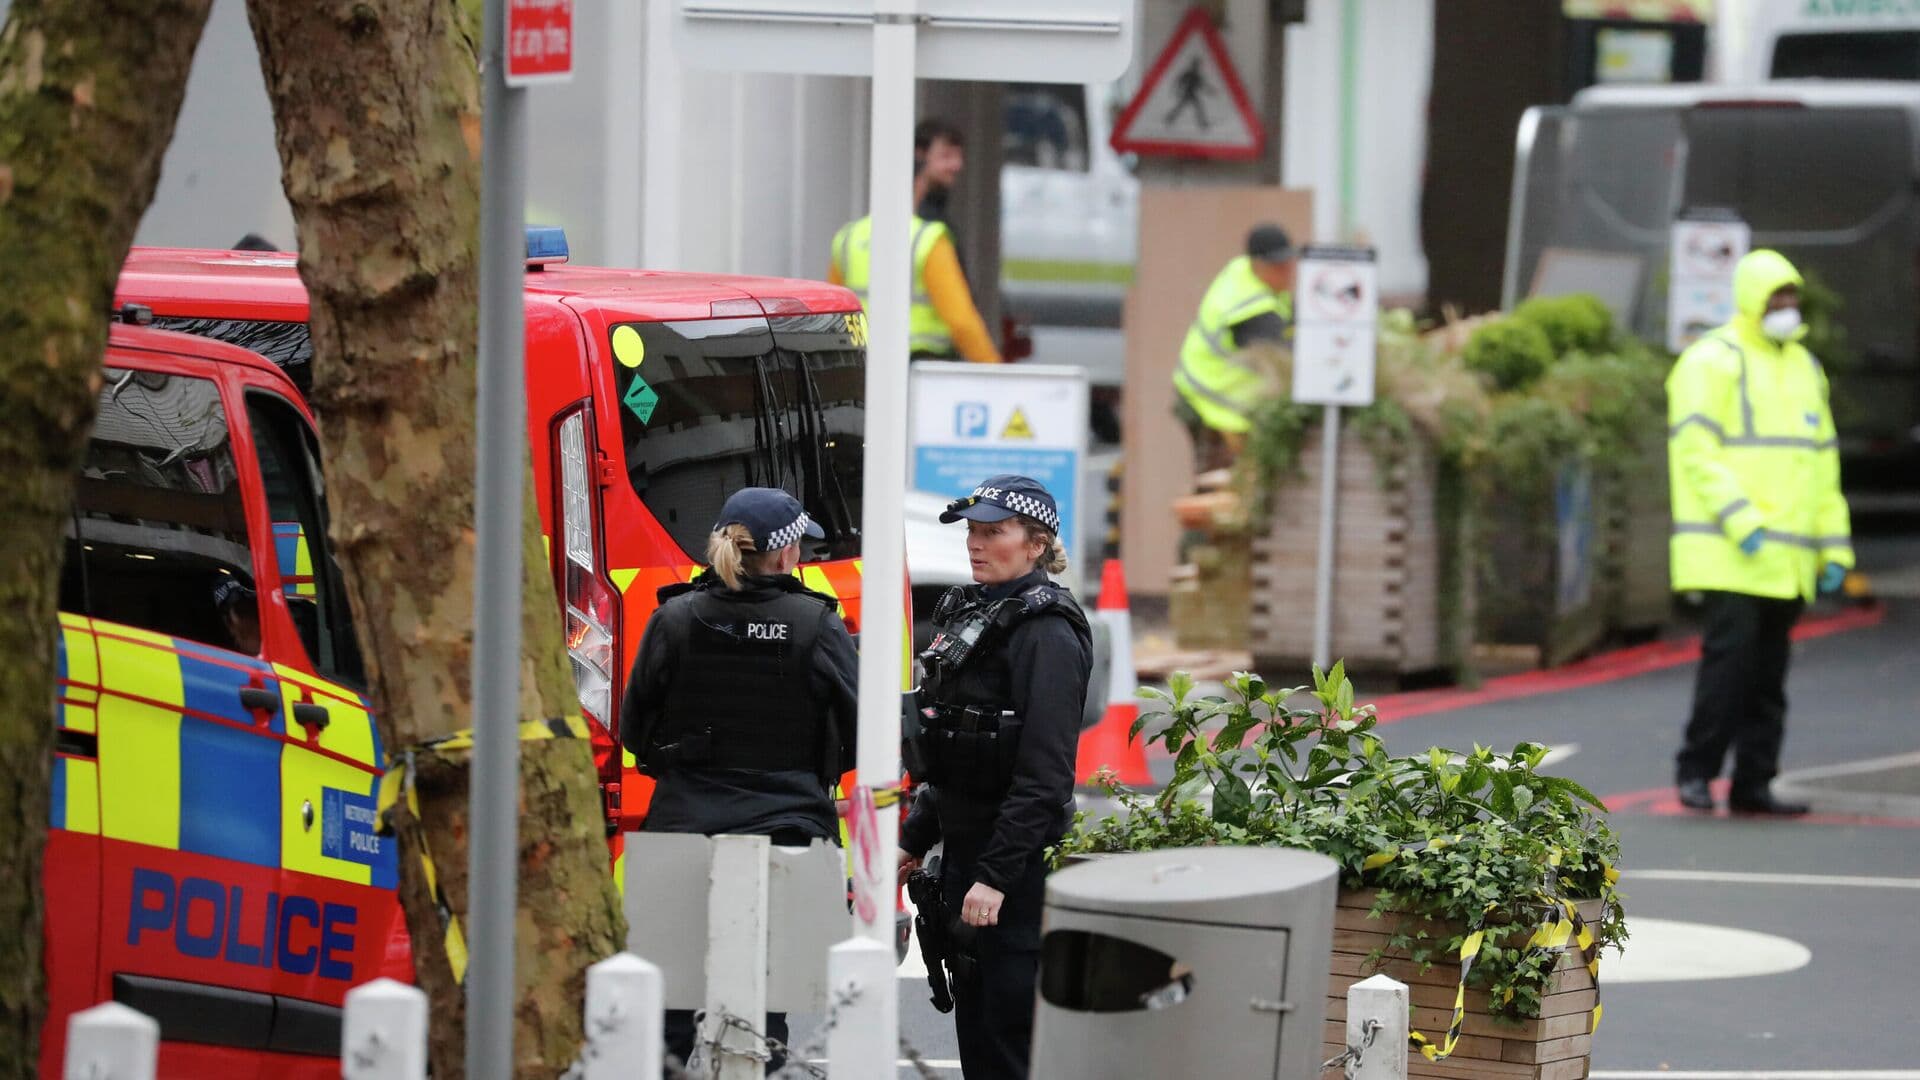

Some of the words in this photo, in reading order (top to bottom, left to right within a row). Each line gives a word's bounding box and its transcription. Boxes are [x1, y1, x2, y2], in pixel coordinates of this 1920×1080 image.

[747, 623, 788, 640] POLICE
[350, 830, 380, 855] POLICE
[127, 867, 358, 982] POLICE
